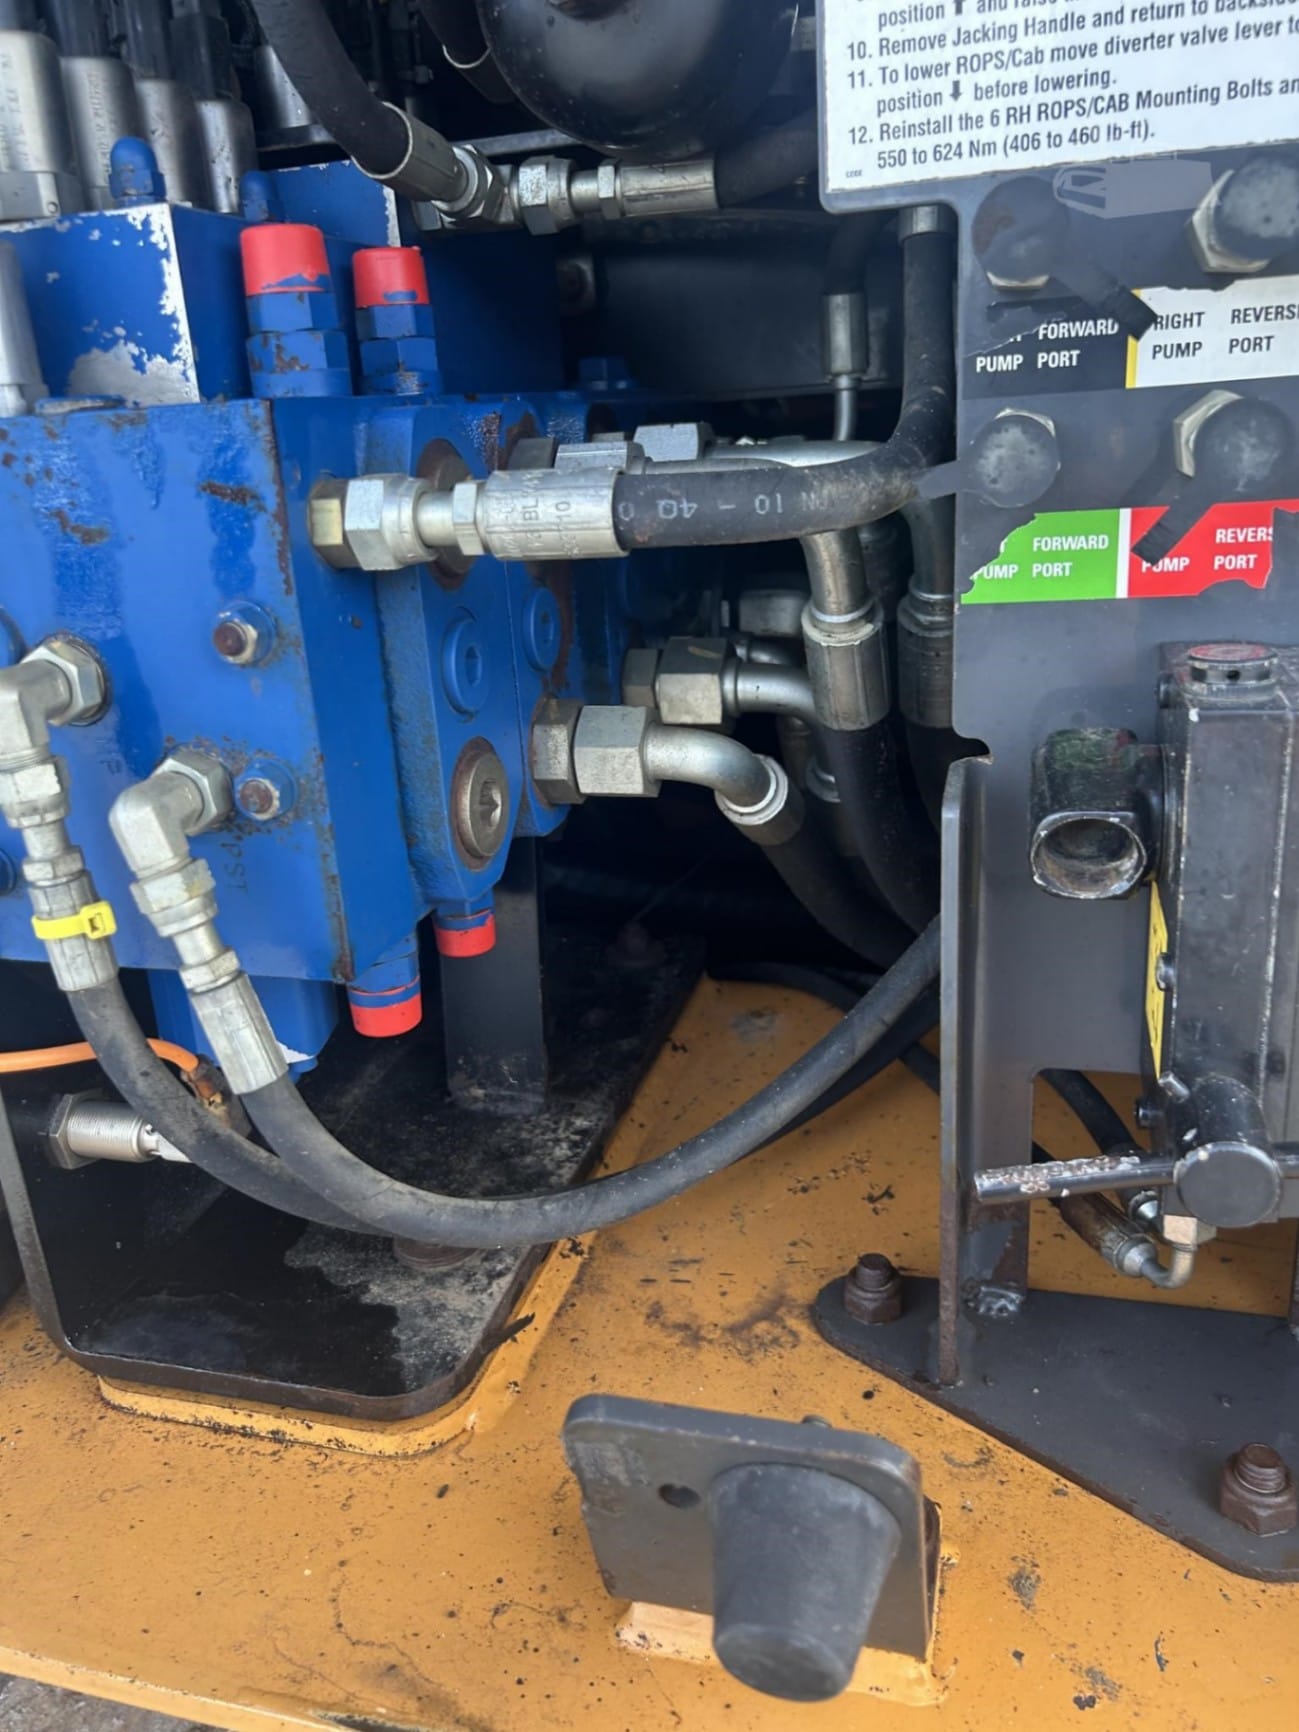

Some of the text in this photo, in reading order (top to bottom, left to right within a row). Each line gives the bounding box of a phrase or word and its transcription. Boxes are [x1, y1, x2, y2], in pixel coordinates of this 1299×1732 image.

[847, 41, 873, 61] 10.
[879, 33, 947, 57] Remove
[952, 22, 1018, 47] Jacking
[1024, 12, 1086, 37] Handle
[1092, 5, 1125, 28] and
[1131, 3, 1185, 25] return
[1192, 0, 1208, 16] to
[878, 3, 945, 32] position
[847, 70, 873, 89] 11.
[879, 66, 899, 85] To
[904, 61, 950, 82] lower
[956, 46, 1044, 75] ROPS/Cab
[1050, 42, 1098, 64] move
[1104, 32, 1174, 56] diverter
[1180, 25, 1228, 47] valve
[1235, 18, 1282, 41] lever
[877, 67, 1117, 117] position before lowering.
[848, 126, 874, 145] 12.
[880, 114, 953, 142] Reinstall
[958, 112, 984, 132] the
[989, 109, 1000, 127] 6
[1006, 104, 1031, 126] RH
[1037, 93, 1130, 122] ROPS/CAB
[1135, 83, 1221, 110] Mounting
[1227, 78, 1273, 101] Bolts
[877, 119, 1155, 169] 550 to 624 Nm (406 to 460 lb-ft).
[1038, 317, 1119, 341] FORWARD
[1153, 303, 1299, 331] RIGHT REVERS
[976, 349, 1081, 373] PUMP PORT
[1152, 335, 1275, 360] PUMP PORT
[1033, 534, 1109, 552] FORWARD
[1032, 562, 1072, 578] PORT
[1214, 553, 1258, 571] PORT
